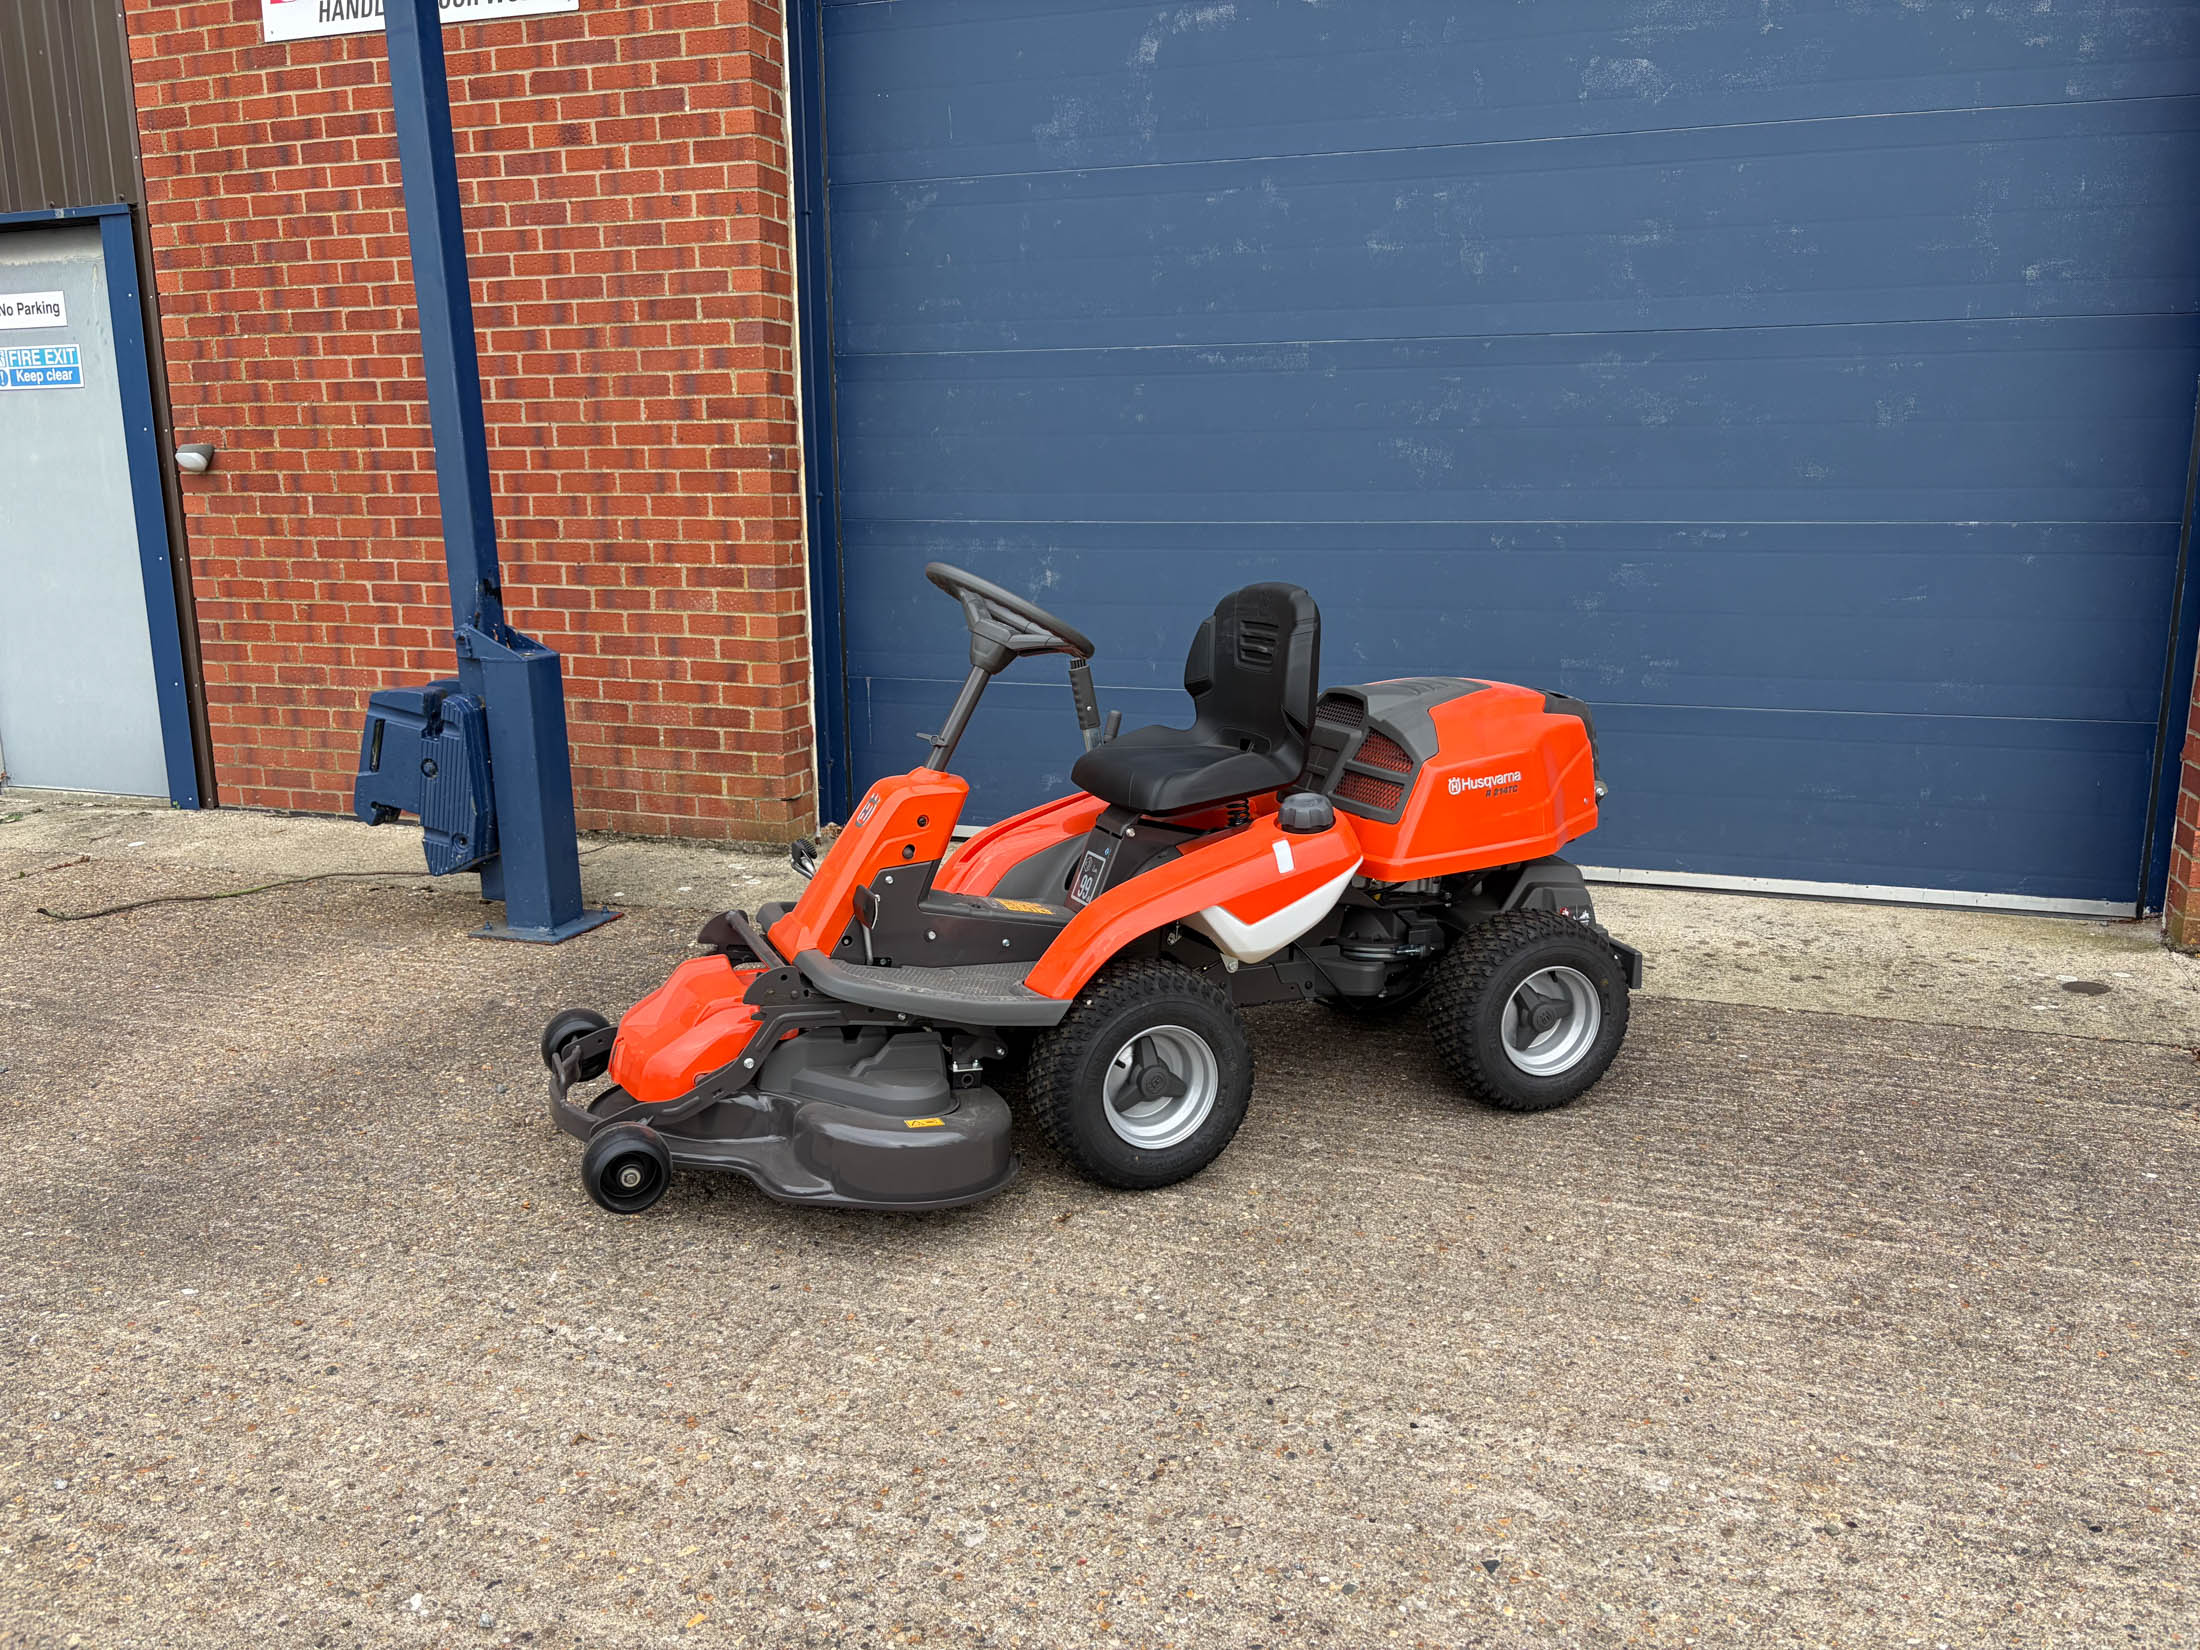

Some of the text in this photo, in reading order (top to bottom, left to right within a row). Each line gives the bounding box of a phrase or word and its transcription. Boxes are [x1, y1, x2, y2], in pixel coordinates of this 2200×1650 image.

[319, 0, 385, 22] HANDL
[0, 301, 60, 317] No Parking
[8, 348, 75, 366] FIRE EXIT
[16, 368, 73, 384] Keep clear
[1462, 771, 1521, 790] Husqvarna
